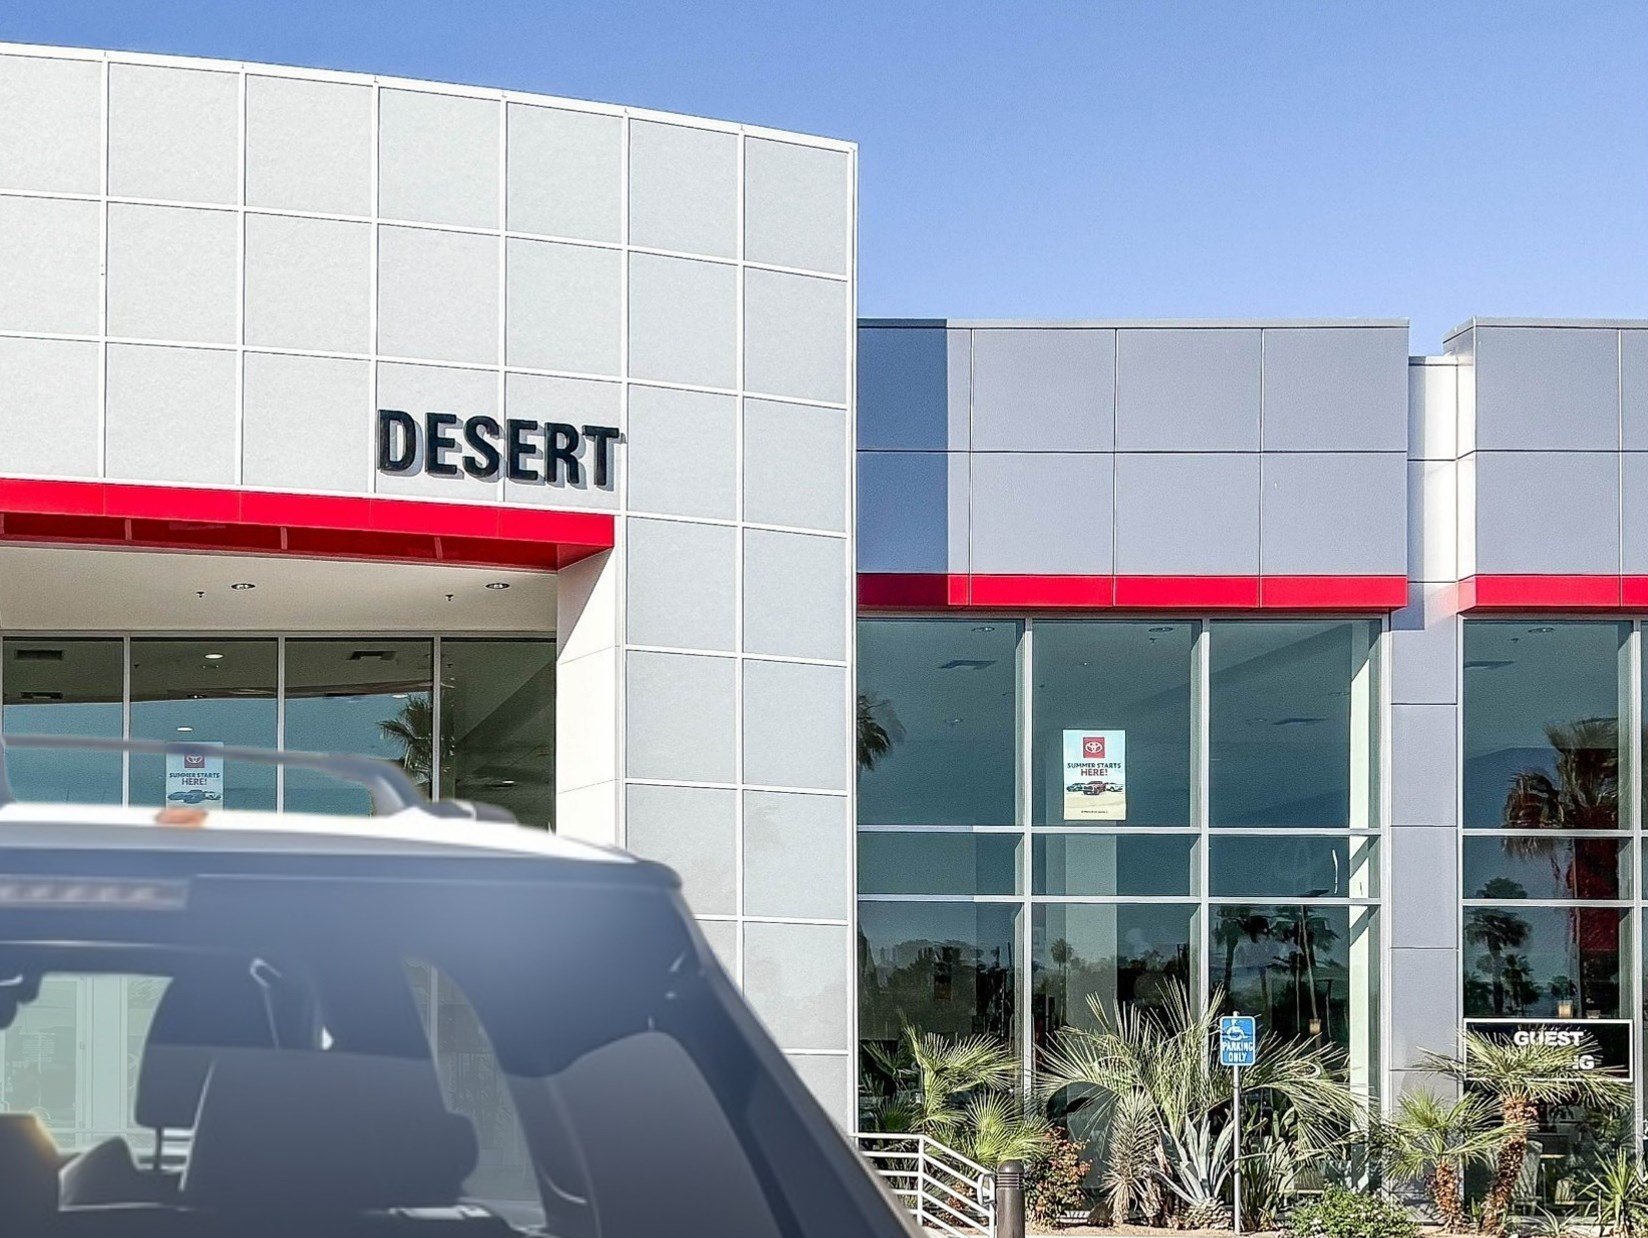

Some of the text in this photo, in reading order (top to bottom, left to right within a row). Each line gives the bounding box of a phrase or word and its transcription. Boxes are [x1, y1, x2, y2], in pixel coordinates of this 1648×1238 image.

[377, 409, 620, 486] DESERT
[1080, 768, 1108, 776] HERE!
[181, 778, 207, 786] HERE!
[1513, 1030, 1584, 1046] GUEST
[1222, 1041, 1254, 1052] PARKING
[1228, 1051, 1247, 1062] ONLY
